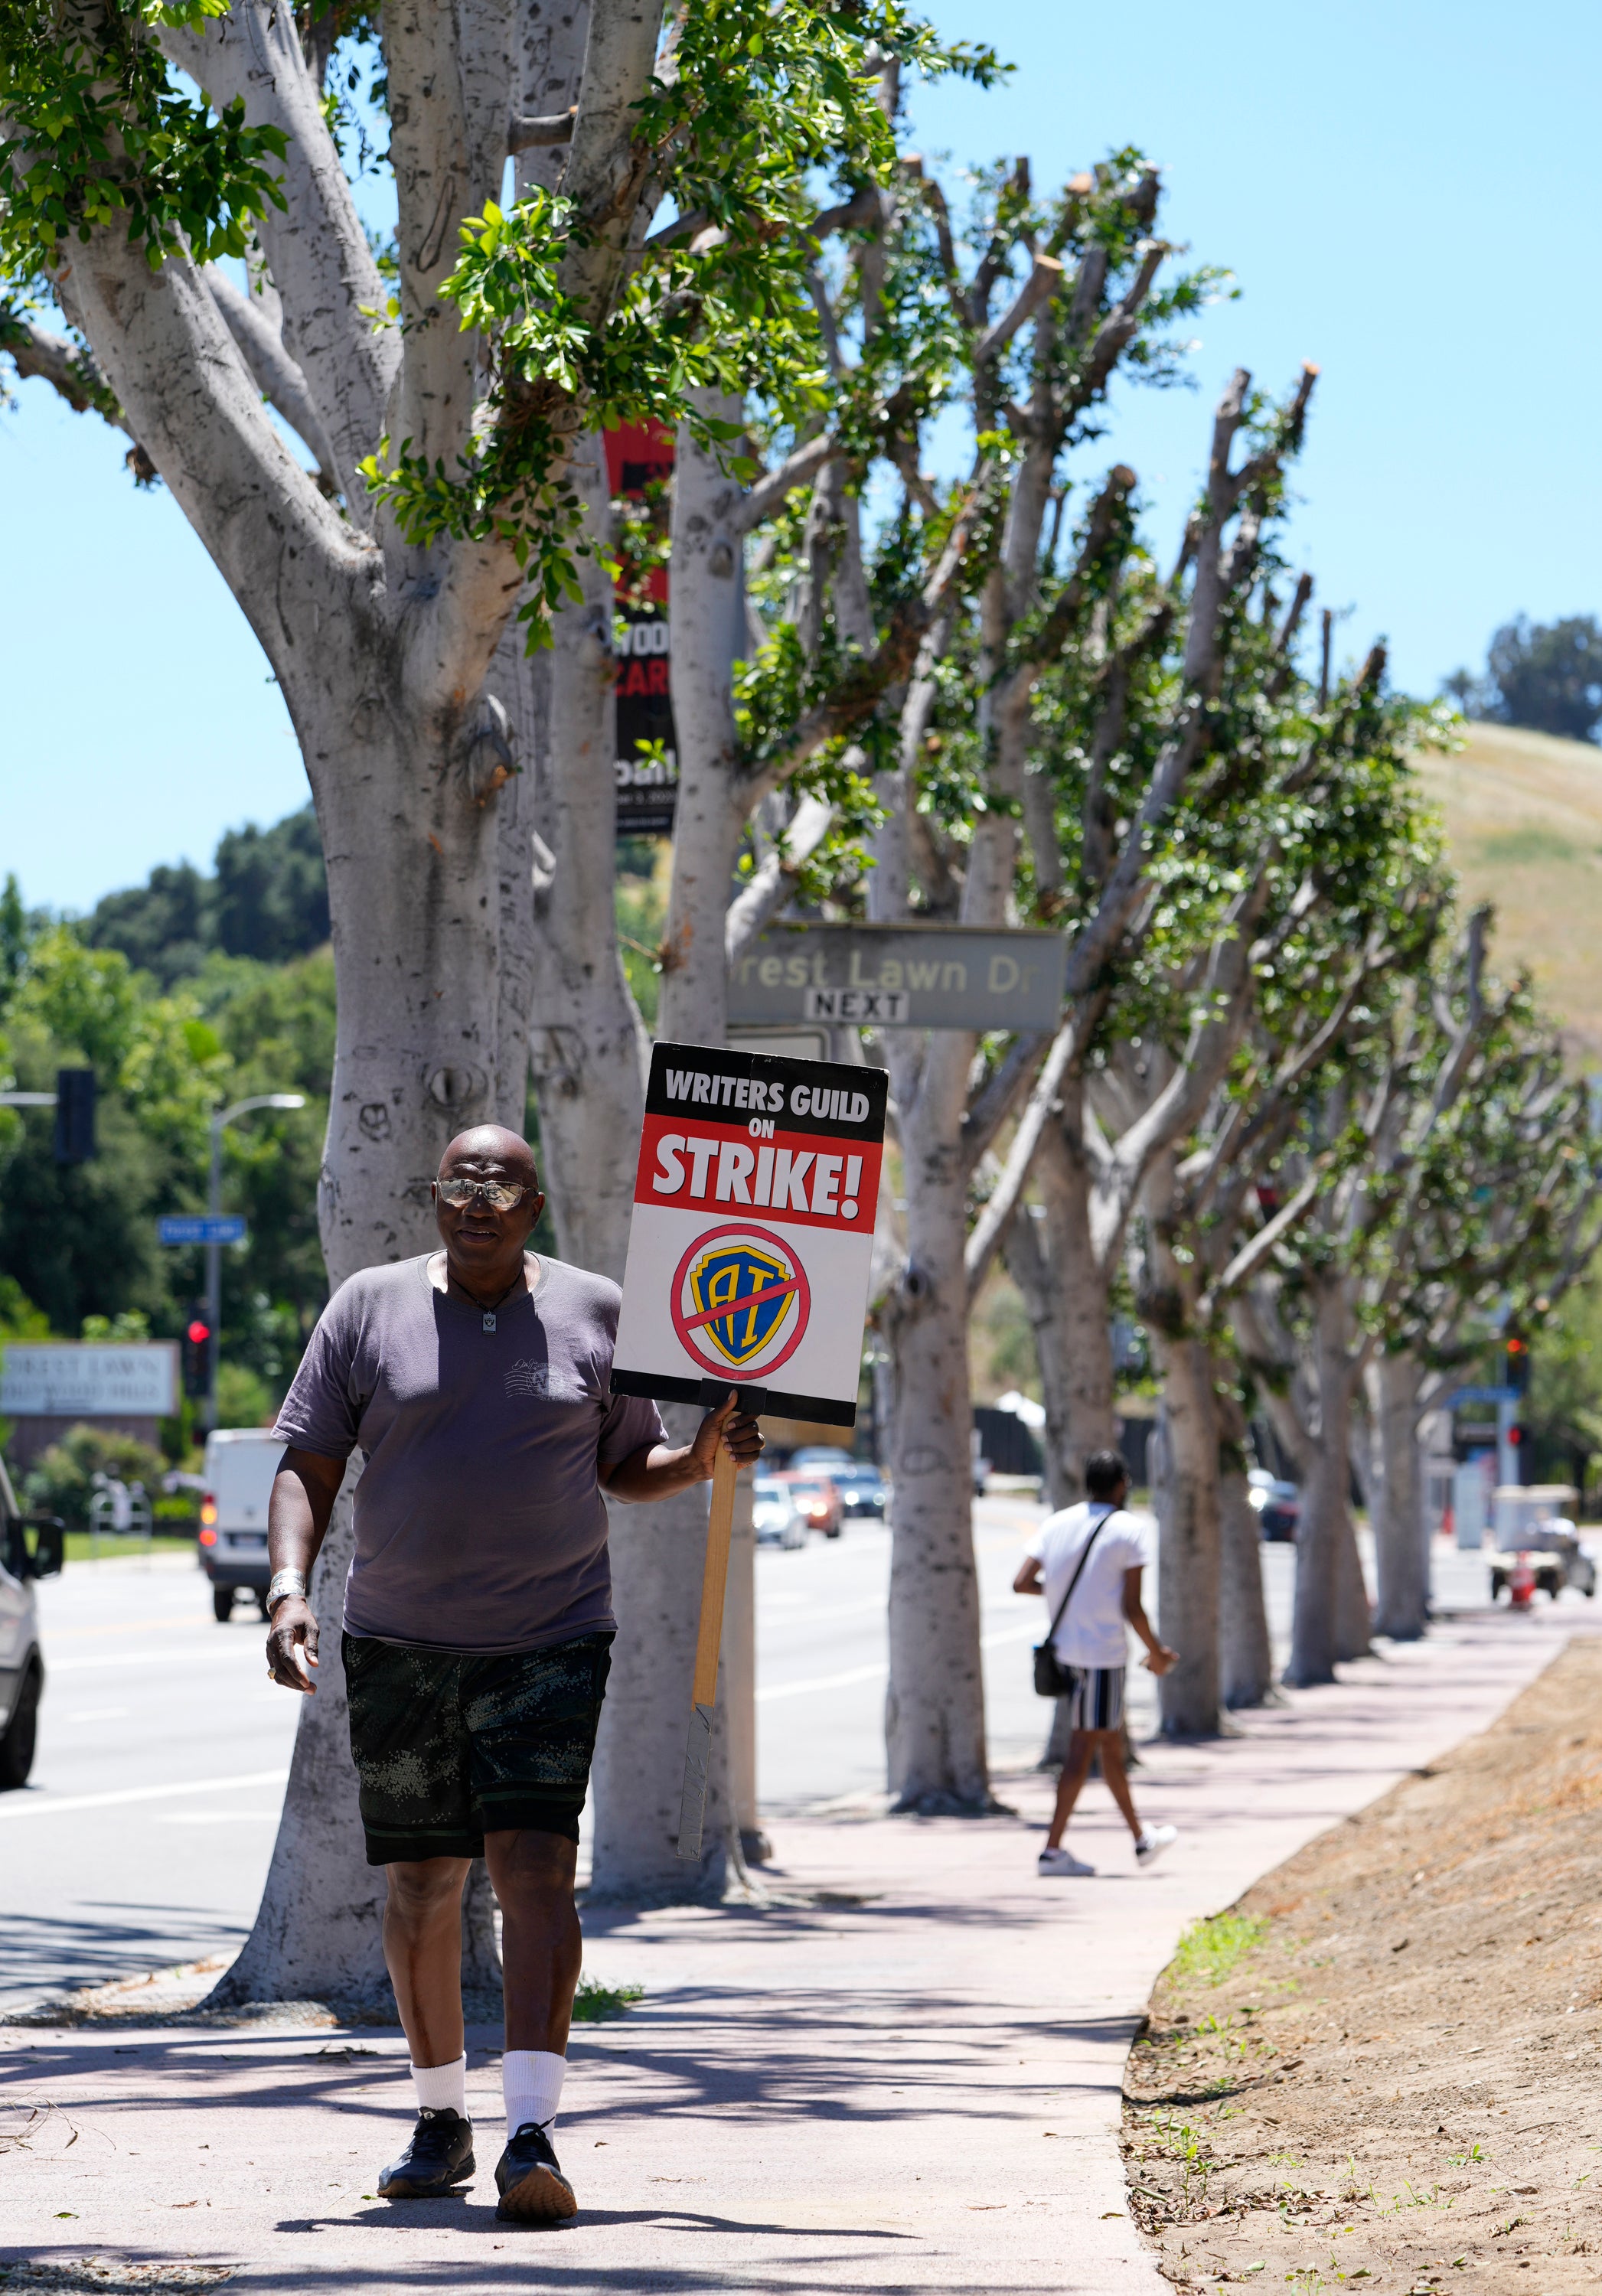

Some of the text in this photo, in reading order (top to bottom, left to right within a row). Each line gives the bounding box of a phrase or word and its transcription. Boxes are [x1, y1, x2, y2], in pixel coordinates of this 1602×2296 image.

[731, 951, 828, 988] rest
[848, 951, 967, 991] Lawn
[813, 994, 901, 1019] NEXT
[665, 1068, 870, 1123] WRITERS GUILD
[748, 1117, 775, 1140] ON
[652, 1133, 863, 1219] STRIKE!
